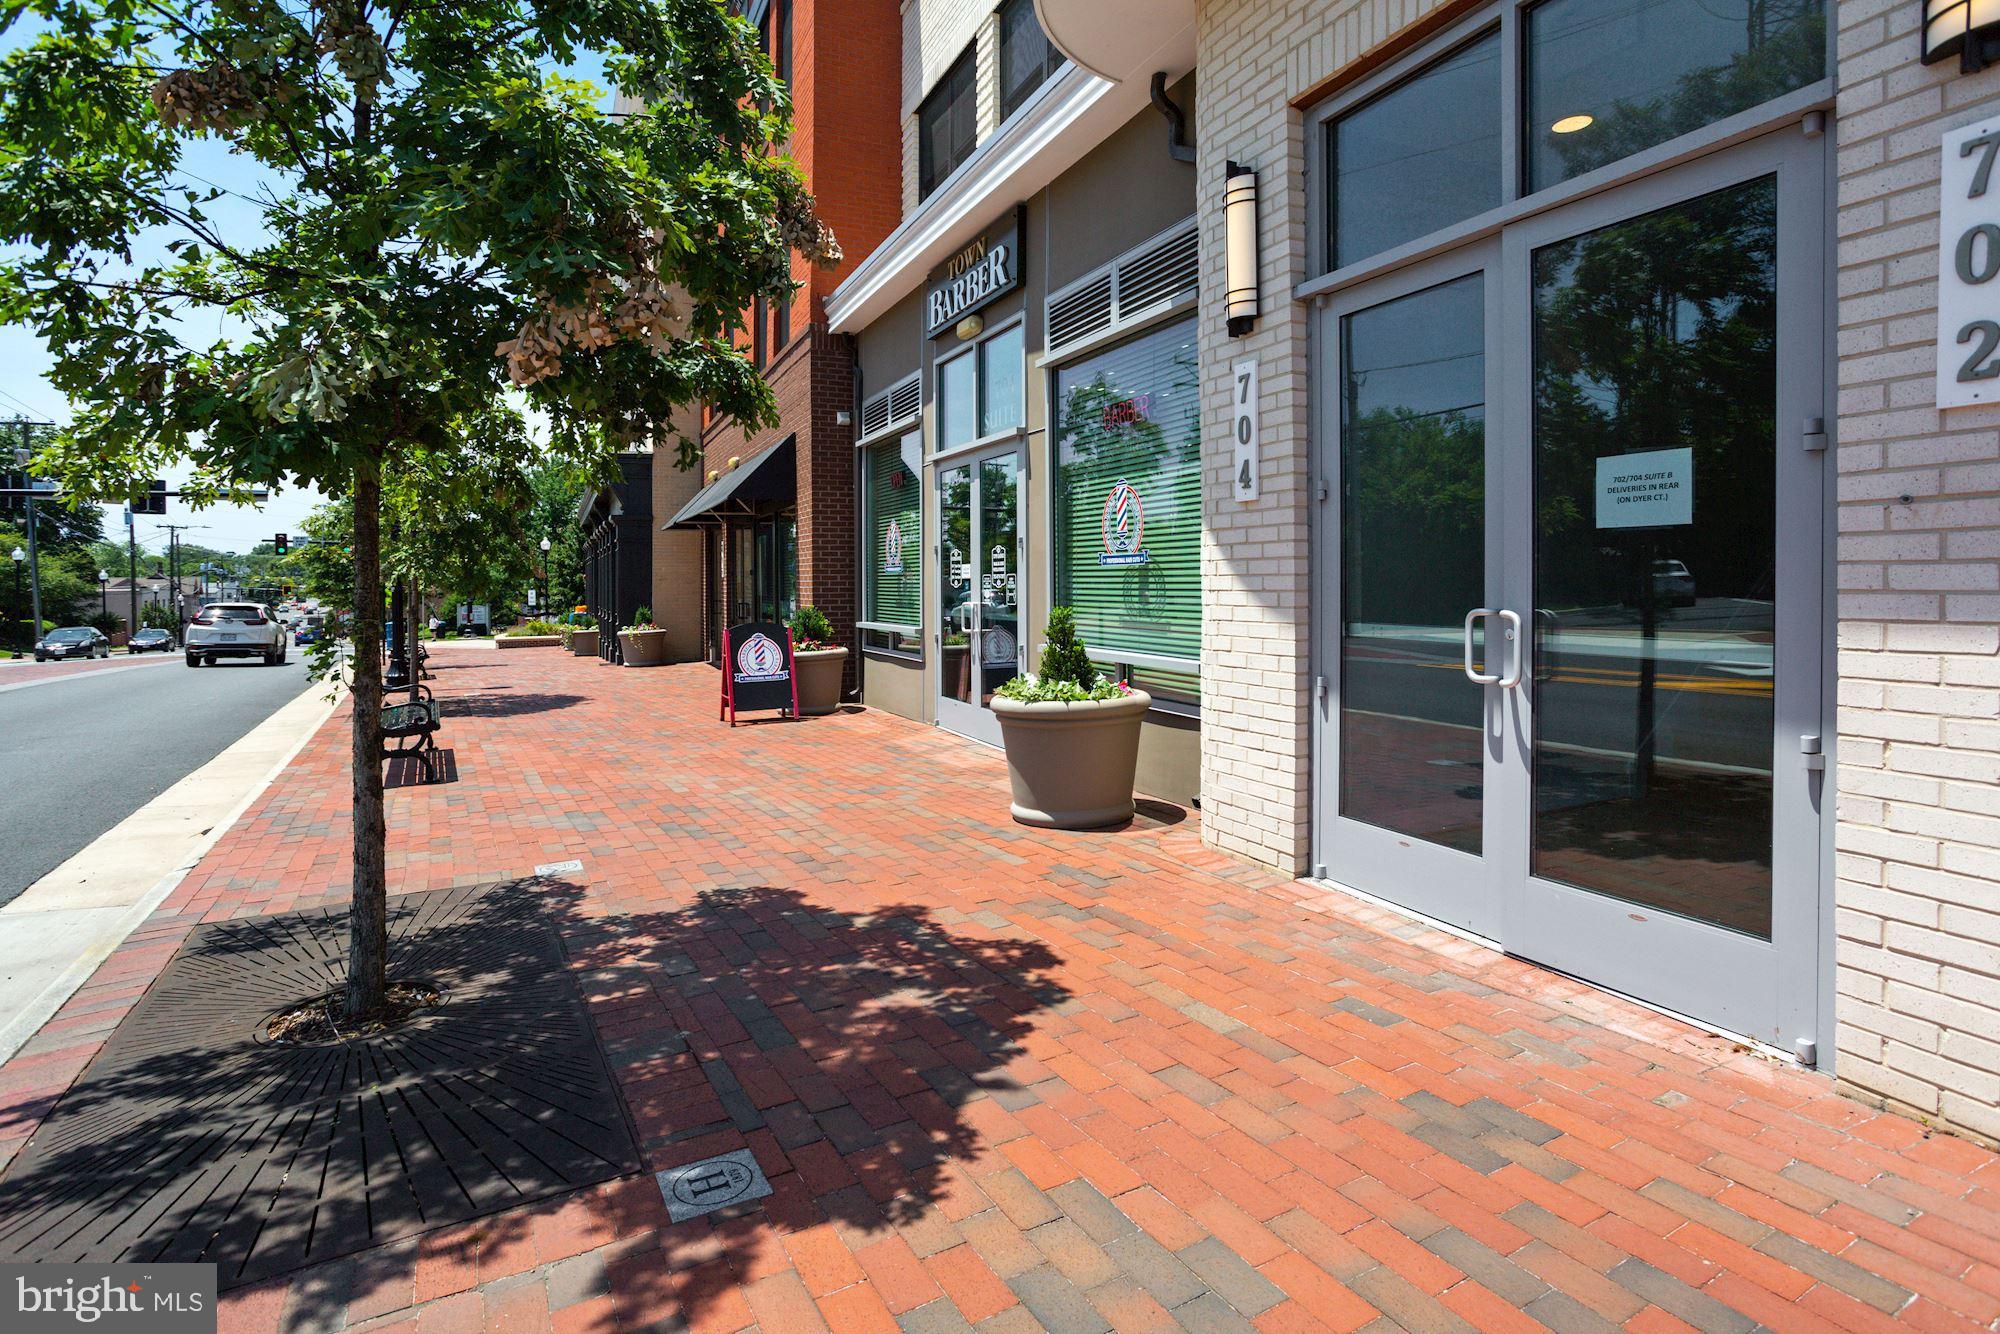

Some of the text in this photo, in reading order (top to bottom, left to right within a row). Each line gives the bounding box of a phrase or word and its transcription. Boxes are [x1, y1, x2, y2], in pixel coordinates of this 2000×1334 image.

[948, 236, 988, 281] TOWN
[1955, 131, 2000, 383] 702
[930, 245, 1009, 332] BARBER
[1103, 395, 1150, 430] BARBER
[1238, 373, 1251, 489] 704
[1607, 484, 1647, 494] DELIVERIES
[1659, 482, 1679, 490] REAR
[1613, 475, 1642, 483] 702/704
[1643, 472, 1665, 480] SUITE
[1616, 493, 1668, 504] (ON DYER CT.)
[687, 1169, 732, 1199] H
